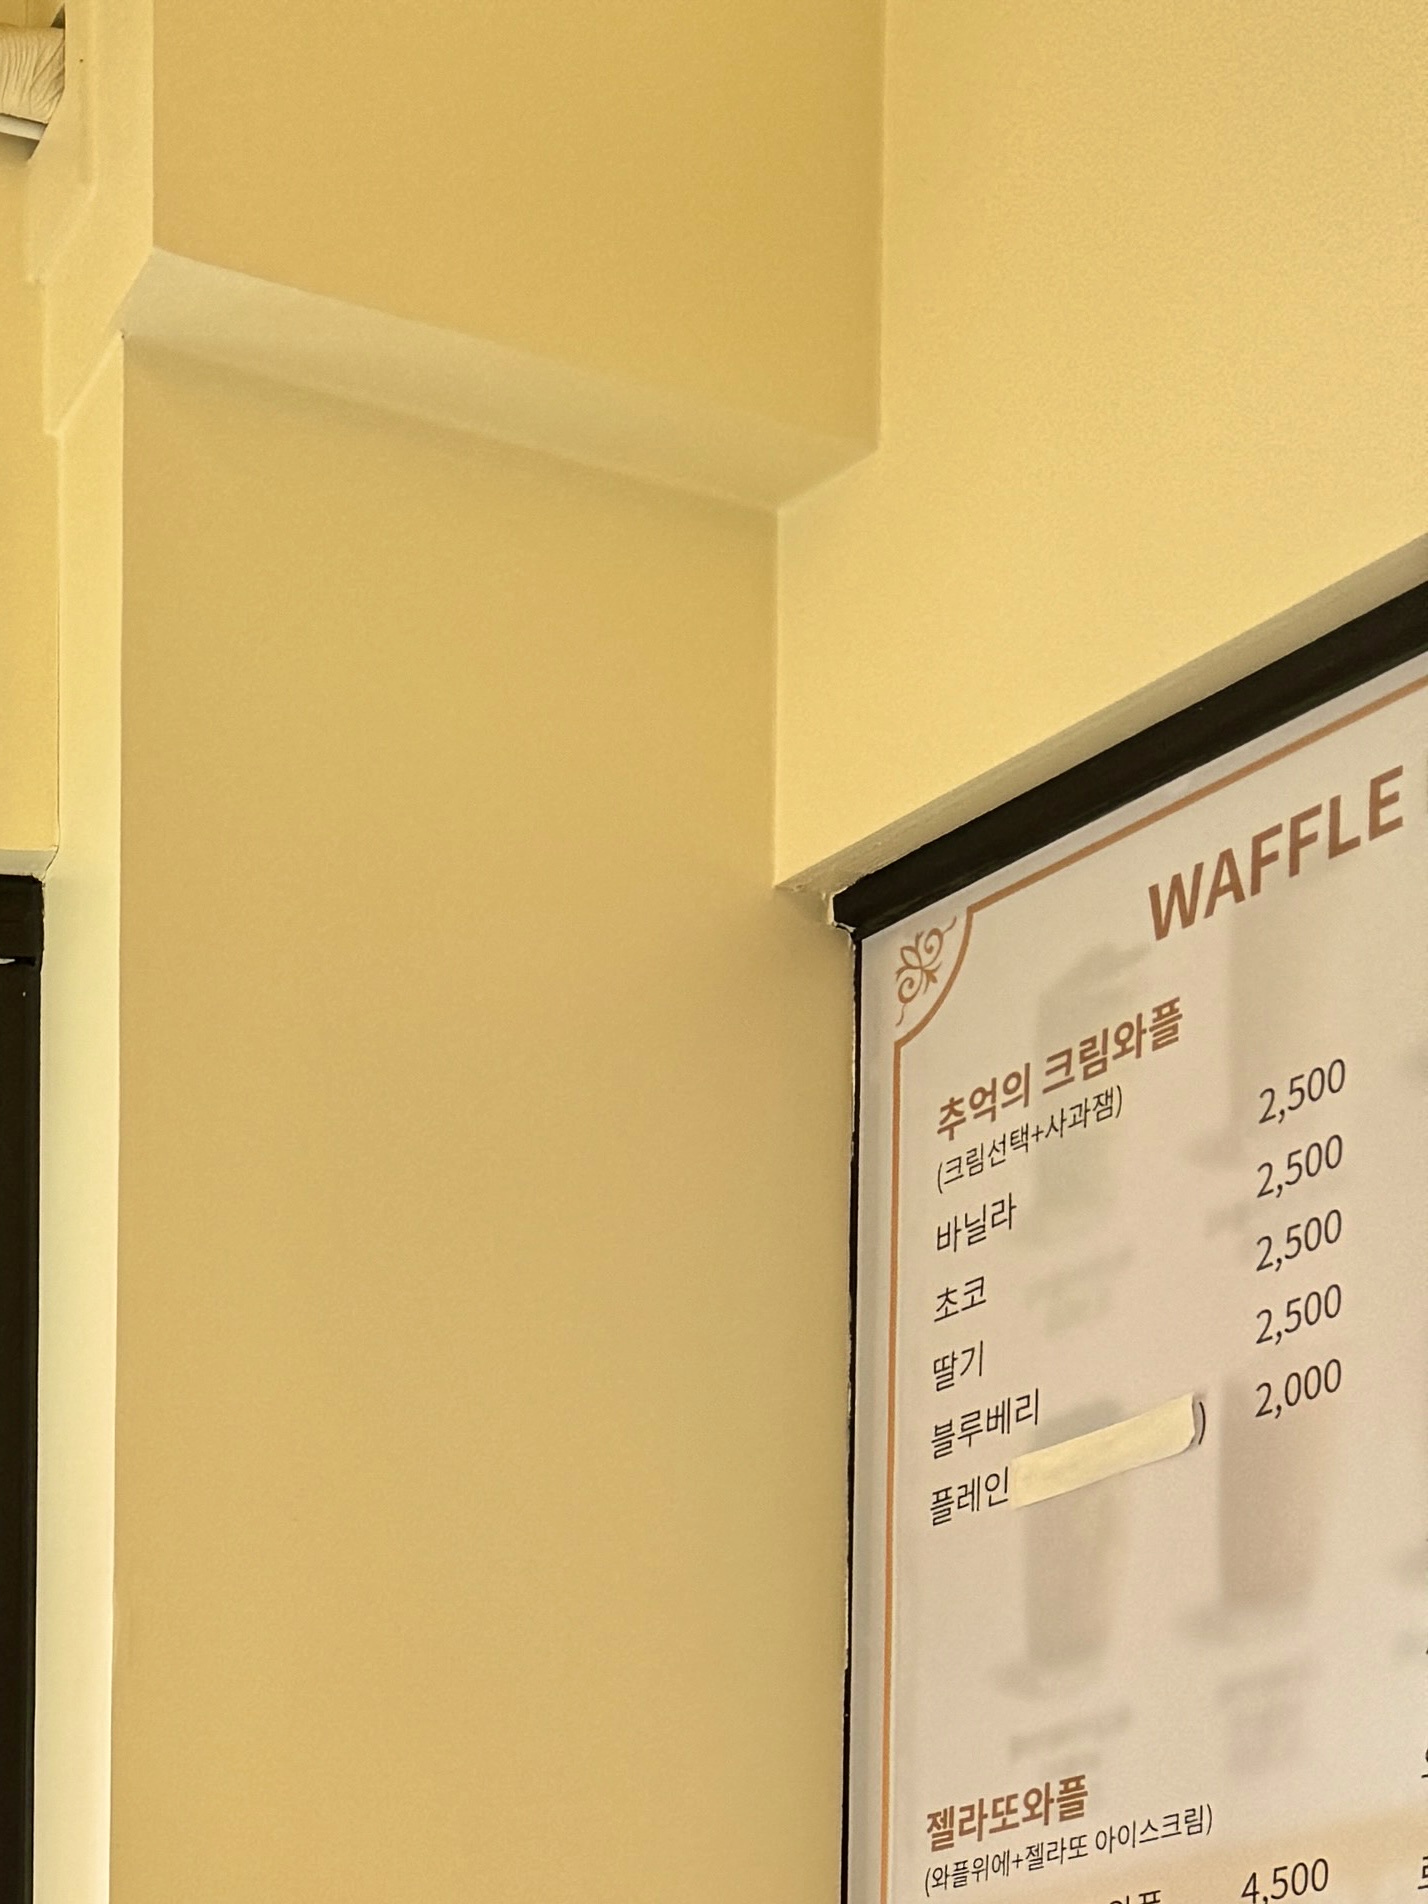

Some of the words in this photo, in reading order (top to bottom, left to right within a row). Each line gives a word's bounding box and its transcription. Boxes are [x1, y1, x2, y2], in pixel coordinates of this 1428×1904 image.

[1148, 764, 1404, 942] WAFFLE
[937, 1062, 1031, 1141] 추억의
[1042, 996, 1183, 1095] 크림와플
[1258, 1058, 1346, 1125] 2,500
[937, 1084, 1123, 1195] (크림선택+사과잼)
[1256, 1133, 1344, 1199] 2,500
[936, 1192, 1017, 1253] 바닐라
[1255, 1208, 1343, 1273] 2,500
[934, 1276, 987, 1323] 초코
[1255, 1283, 1343, 1346] 2,500
[933, 1340, 984, 1392] 딸기
[1255, 1358, 1343, 1420] 2,000
[931, 1387, 1040, 1460] 블루베리
[930, 1465, 1009, 1527] 플레인
[926, 1773, 1089, 1854] 젤라또와플
[924, 1833, 1089, 1898] (와플위에+젤라또
[1095, 1803, 1213, 1854] 아이스크림)
